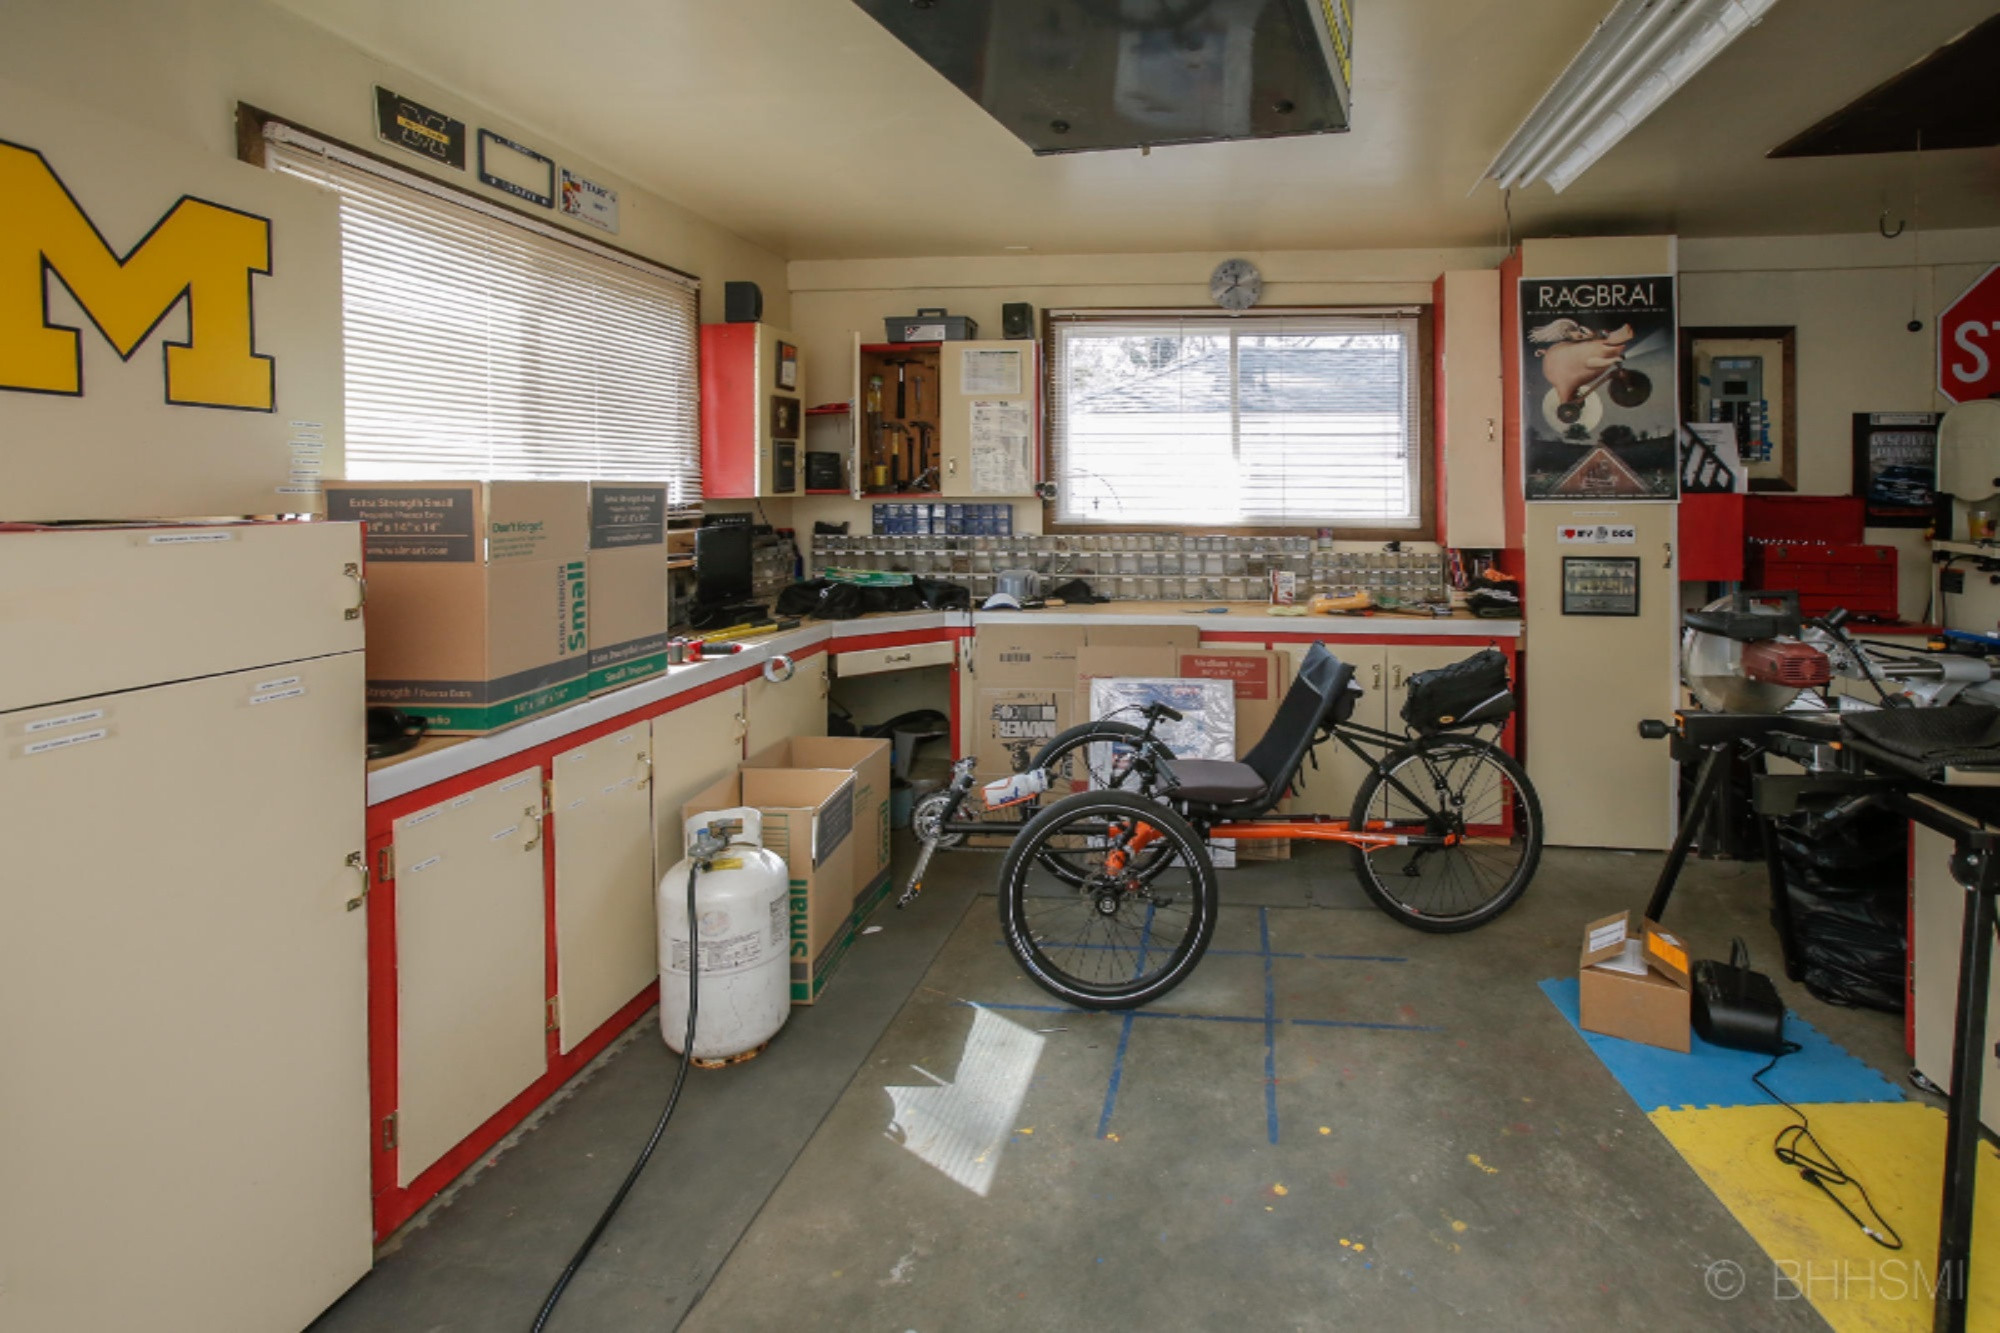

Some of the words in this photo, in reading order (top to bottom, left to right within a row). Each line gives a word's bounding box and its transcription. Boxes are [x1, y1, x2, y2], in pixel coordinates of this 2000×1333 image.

[0, 139, 276, 412] M
[1538, 283, 1655, 309] RAGBRAI
[1952, 320, 2000, 383] S
[377, 497, 423, 510] Strength
[424, 497, 454, 508] Small
[566, 561, 586, 652] Small
[790, 879, 808, 958] Small
